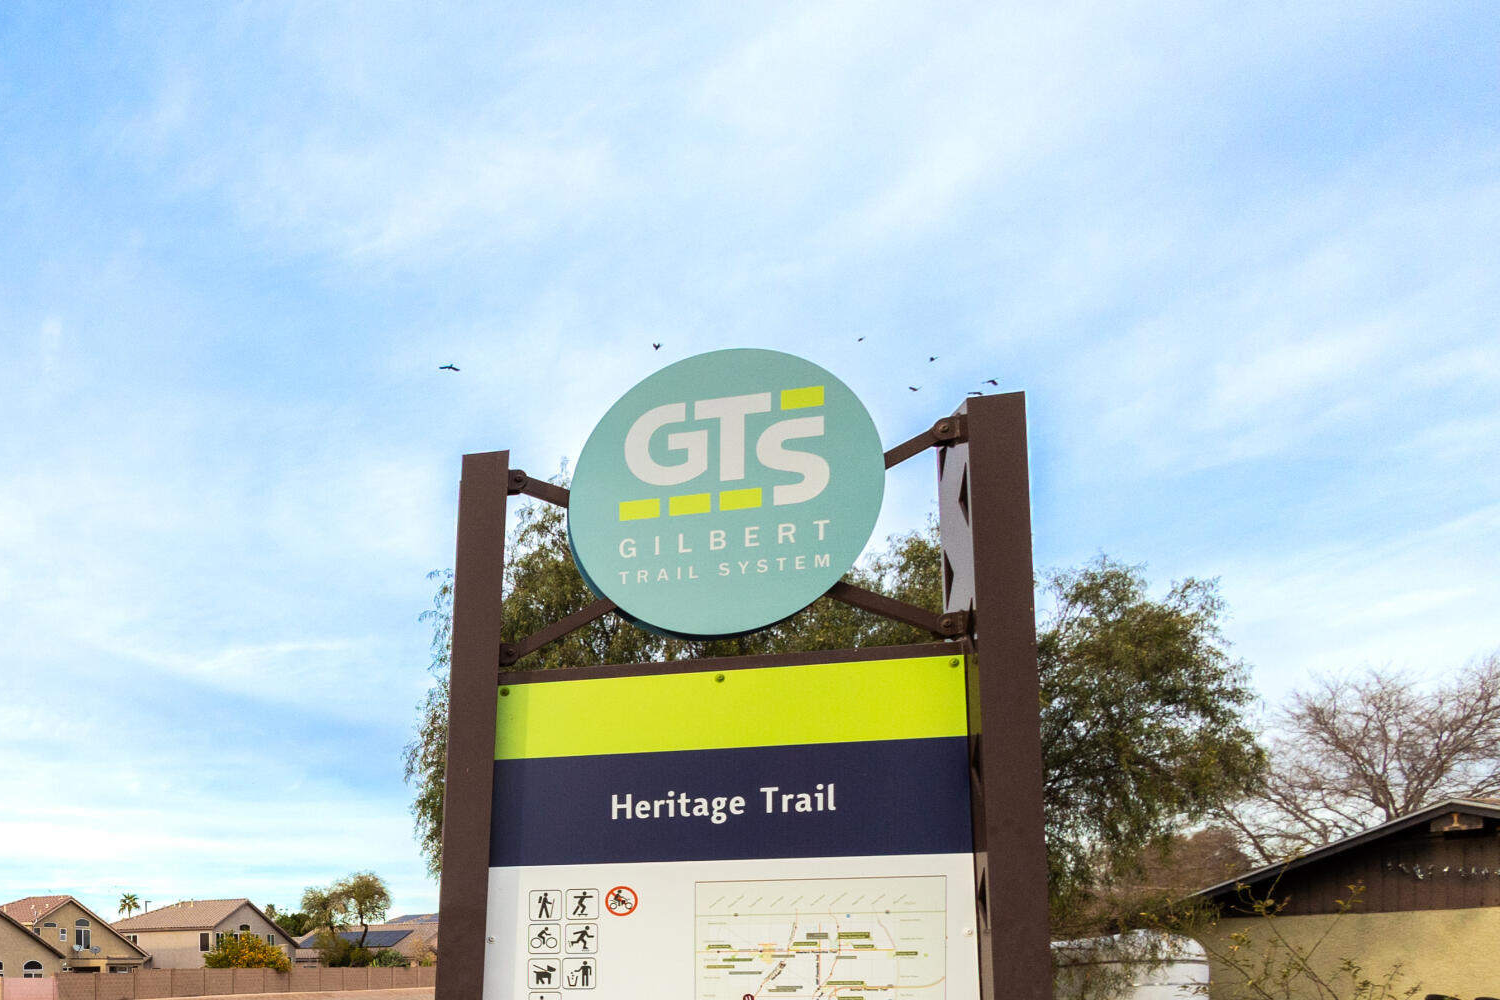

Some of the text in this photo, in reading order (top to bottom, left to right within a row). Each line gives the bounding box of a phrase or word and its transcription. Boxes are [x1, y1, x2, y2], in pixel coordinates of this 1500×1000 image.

[624, 391, 830, 506] GTS
[618, 519, 830, 559] GILBERT
[618, 554, 831, 585] TRAIL SYSTEM
[611, 783, 836, 825] Heritage Trail
